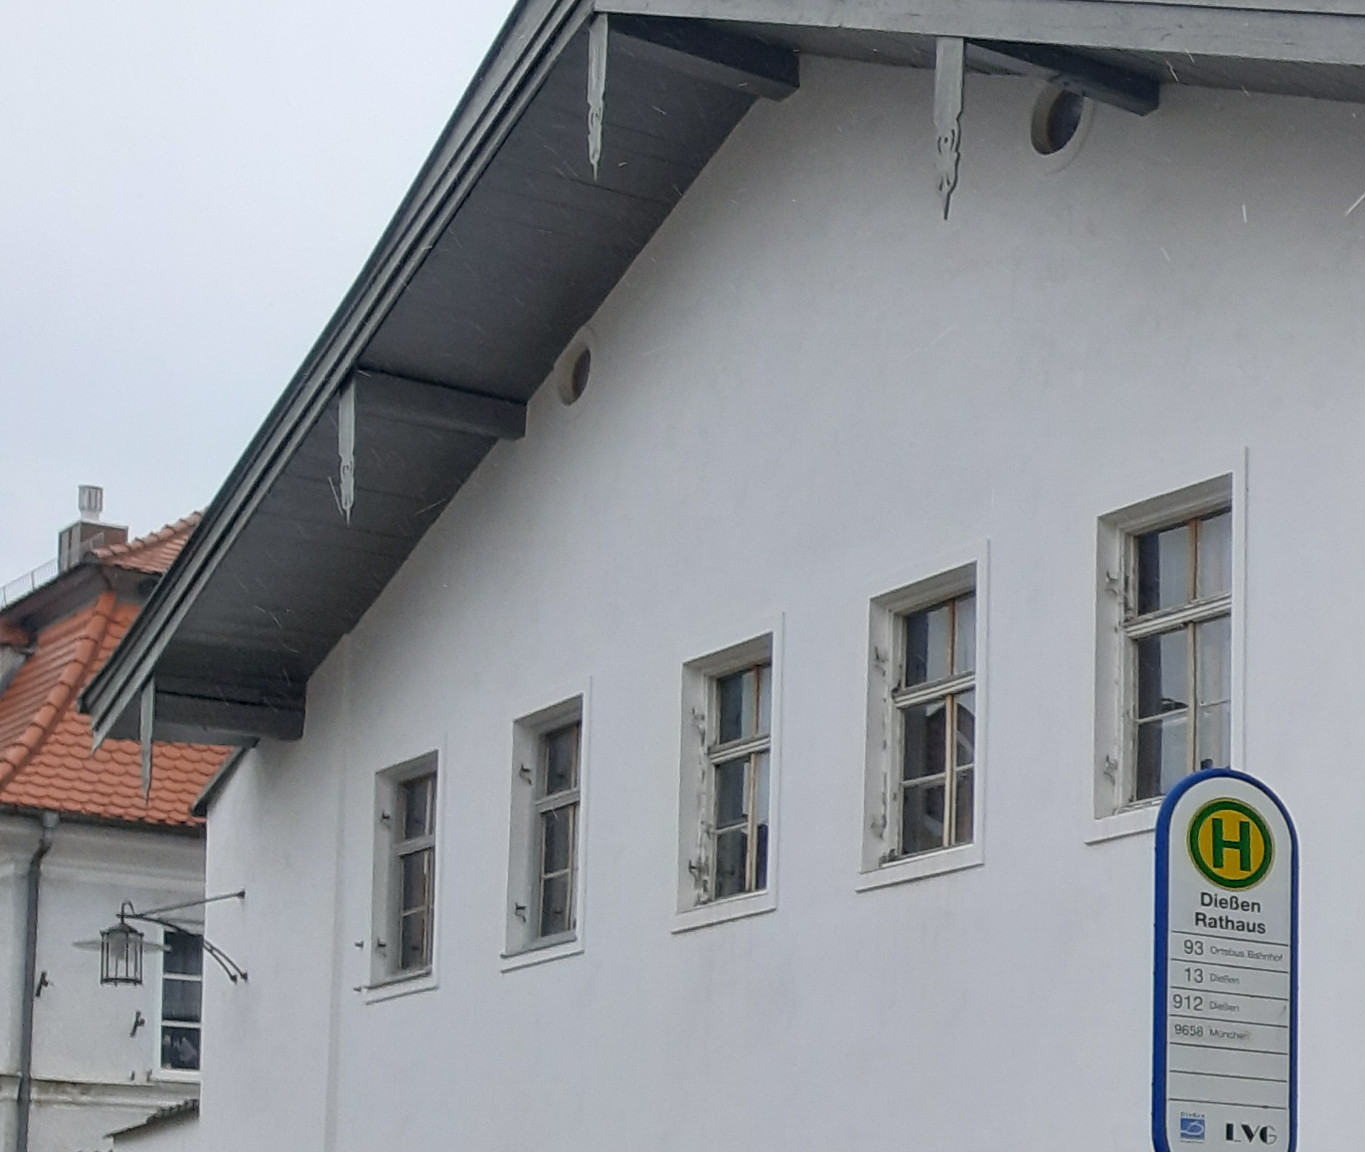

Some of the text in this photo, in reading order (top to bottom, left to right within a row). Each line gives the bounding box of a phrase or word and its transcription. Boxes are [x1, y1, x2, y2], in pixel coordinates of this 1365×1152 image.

[1212, 818, 1251, 871] H
[1200, 892, 1261, 913] Dießen
[1195, 912, 1266, 934] Rathaus
[1184, 940, 1204, 956] 93
[1185, 967, 1204, 983] 13
[1173, 994, 1203, 1011] 912
[1225, 1122, 1277, 1145] LVG
